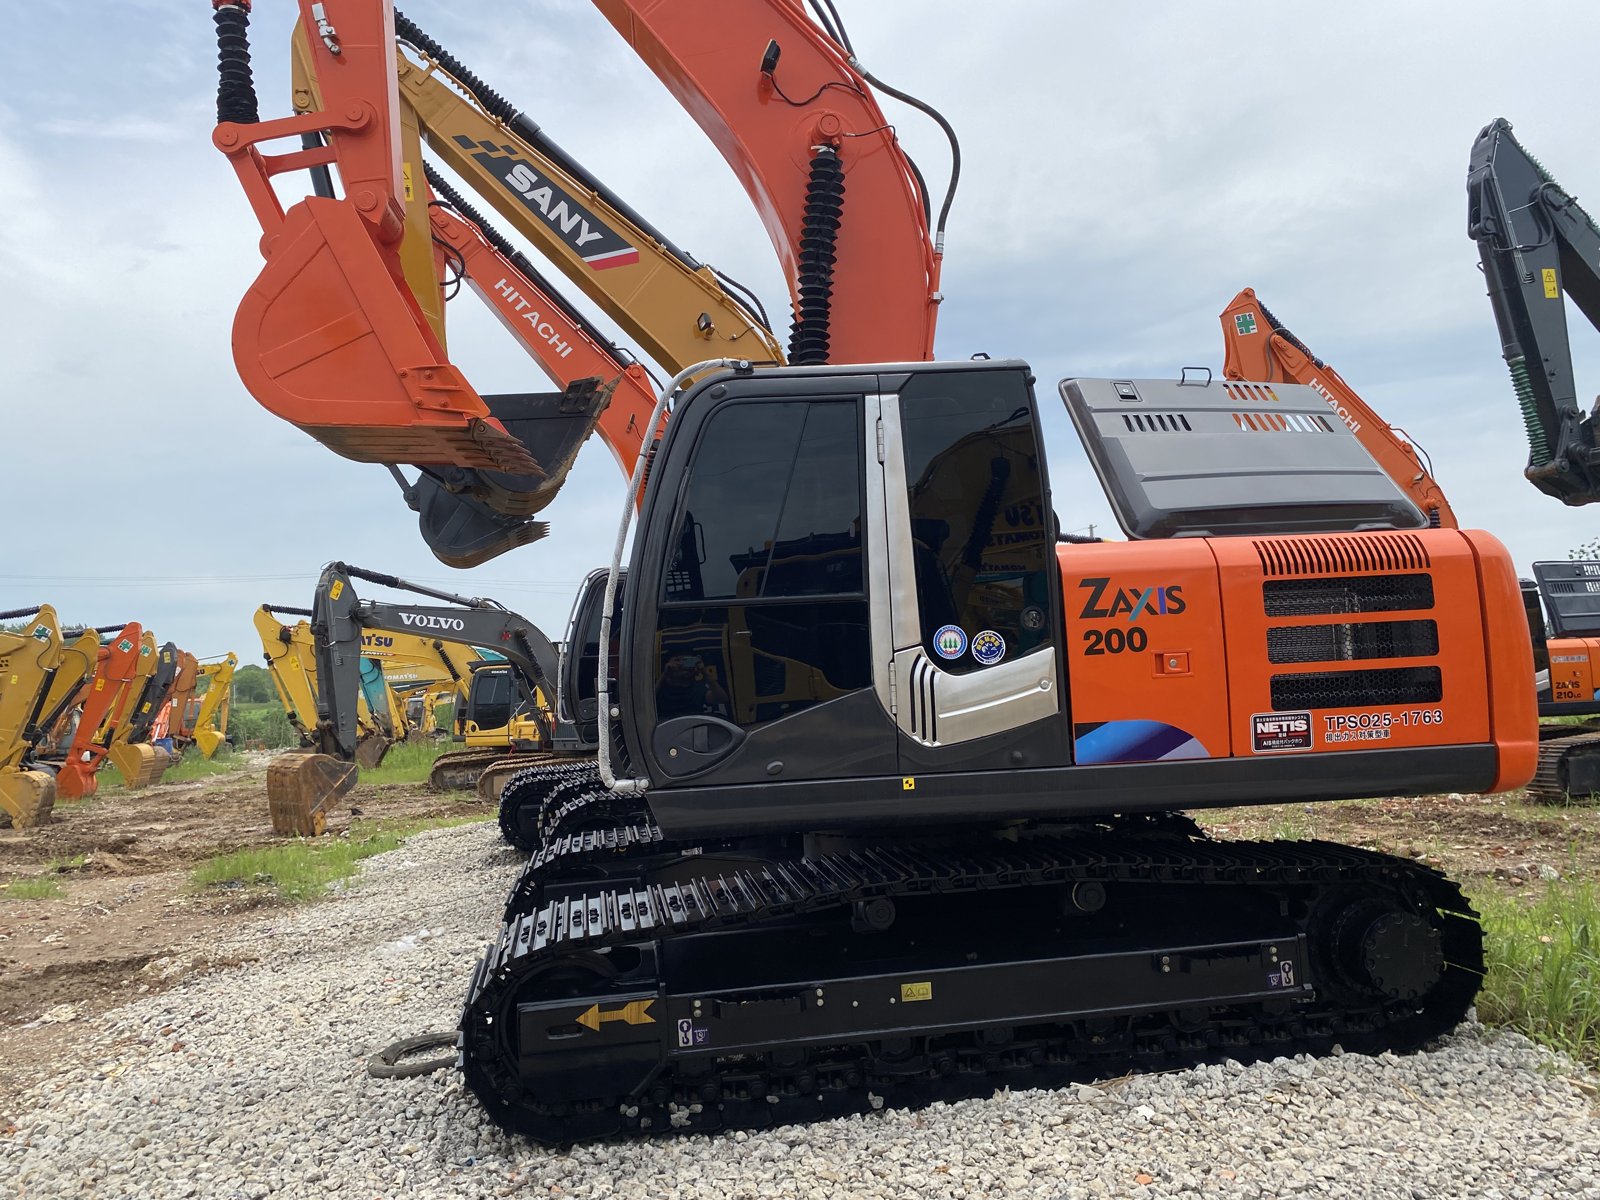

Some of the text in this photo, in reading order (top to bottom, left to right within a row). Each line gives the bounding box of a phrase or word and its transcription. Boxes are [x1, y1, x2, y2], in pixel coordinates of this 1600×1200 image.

[504, 163, 604, 247] SANY
[494, 278, 573, 358] HITACHI
[1308, 378, 1362, 434] HITACHI
[1079, 577, 1186, 621] ZAXIS
[398, 612, 465, 631] VOLVO
[1083, 627, 1148, 656] 200
[1256, 720, 1308, 734] NETIS
